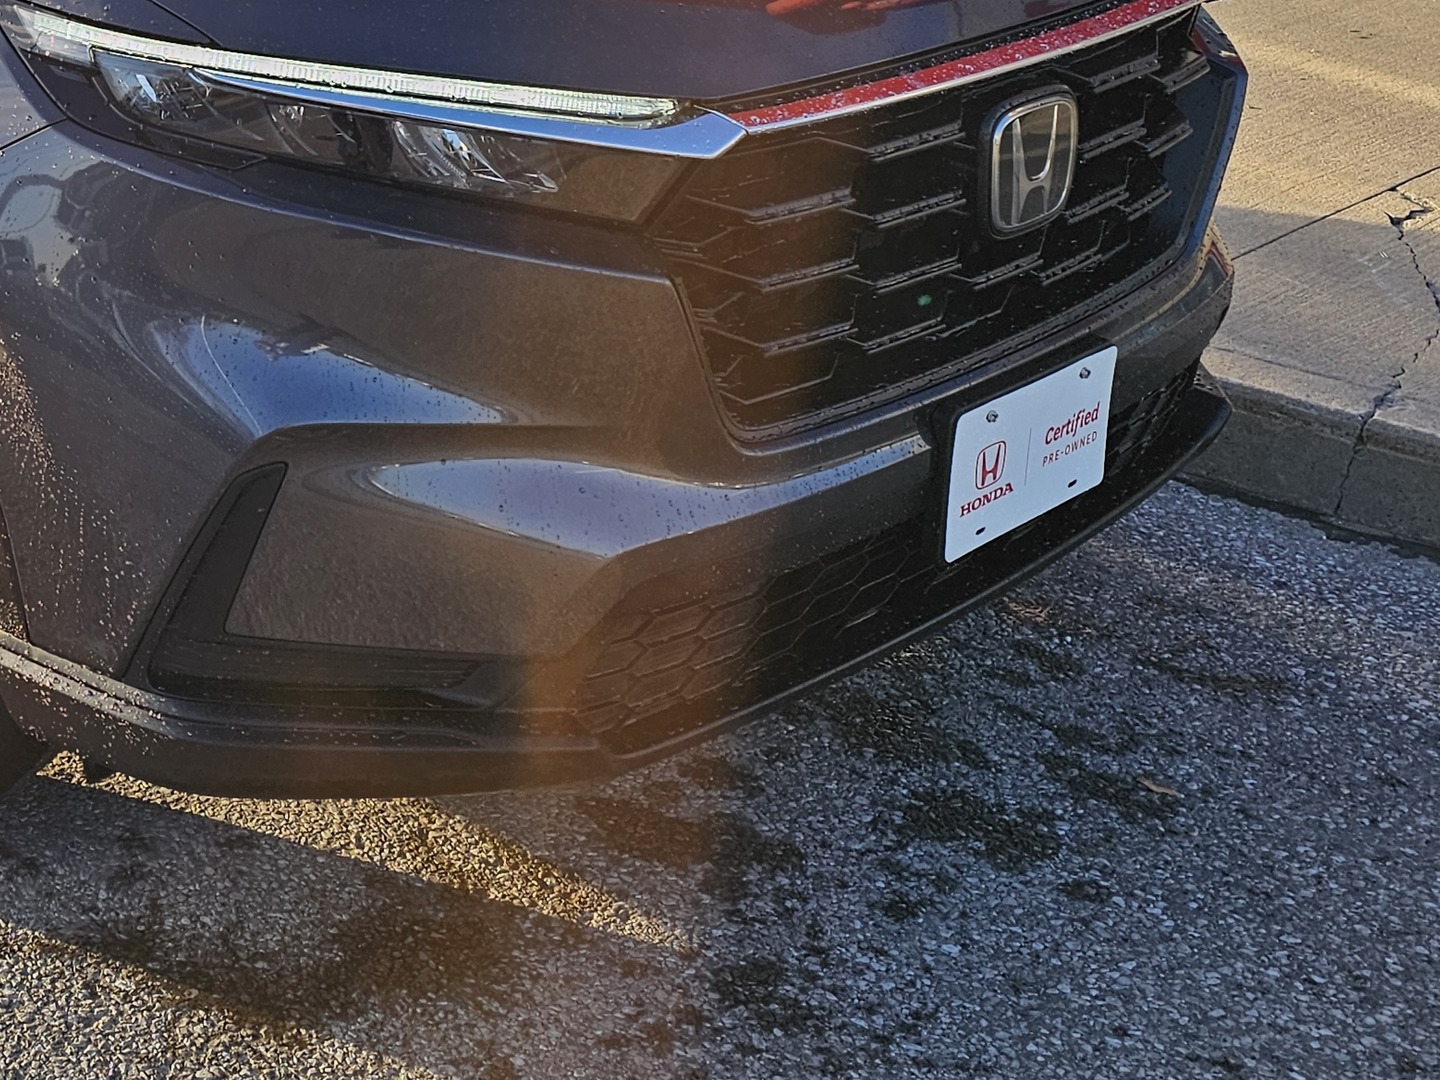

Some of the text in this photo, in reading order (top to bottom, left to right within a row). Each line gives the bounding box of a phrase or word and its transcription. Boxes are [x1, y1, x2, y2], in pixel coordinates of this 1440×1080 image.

[1045, 401, 1100, 445] Certified
[1042, 431, 1098, 467] PRE-OWNED
[960, 482, 1014, 517] HONDA
